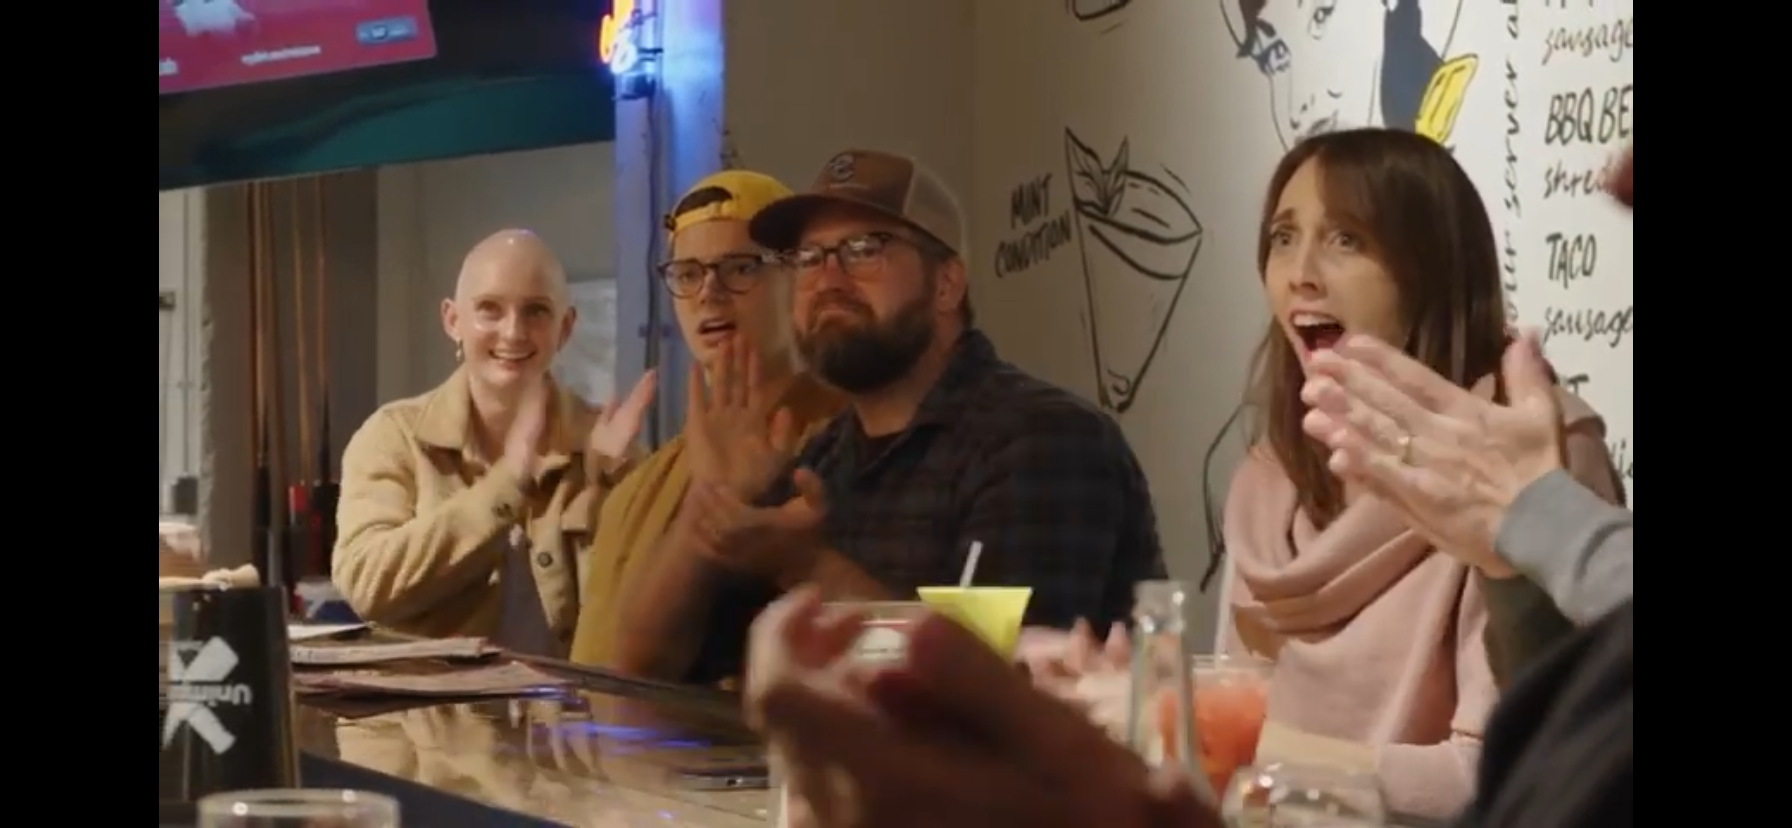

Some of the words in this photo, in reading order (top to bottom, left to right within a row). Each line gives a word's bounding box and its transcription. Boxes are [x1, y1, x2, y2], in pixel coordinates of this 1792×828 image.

[1504, 57, 1521, 218] server
[1545, 86, 1594, 146] BBQ
[1011, 172, 1052, 230] MINT
[994, 208, 1071, 278] CONDITION
[1545, 231, 1597, 290] TACO
